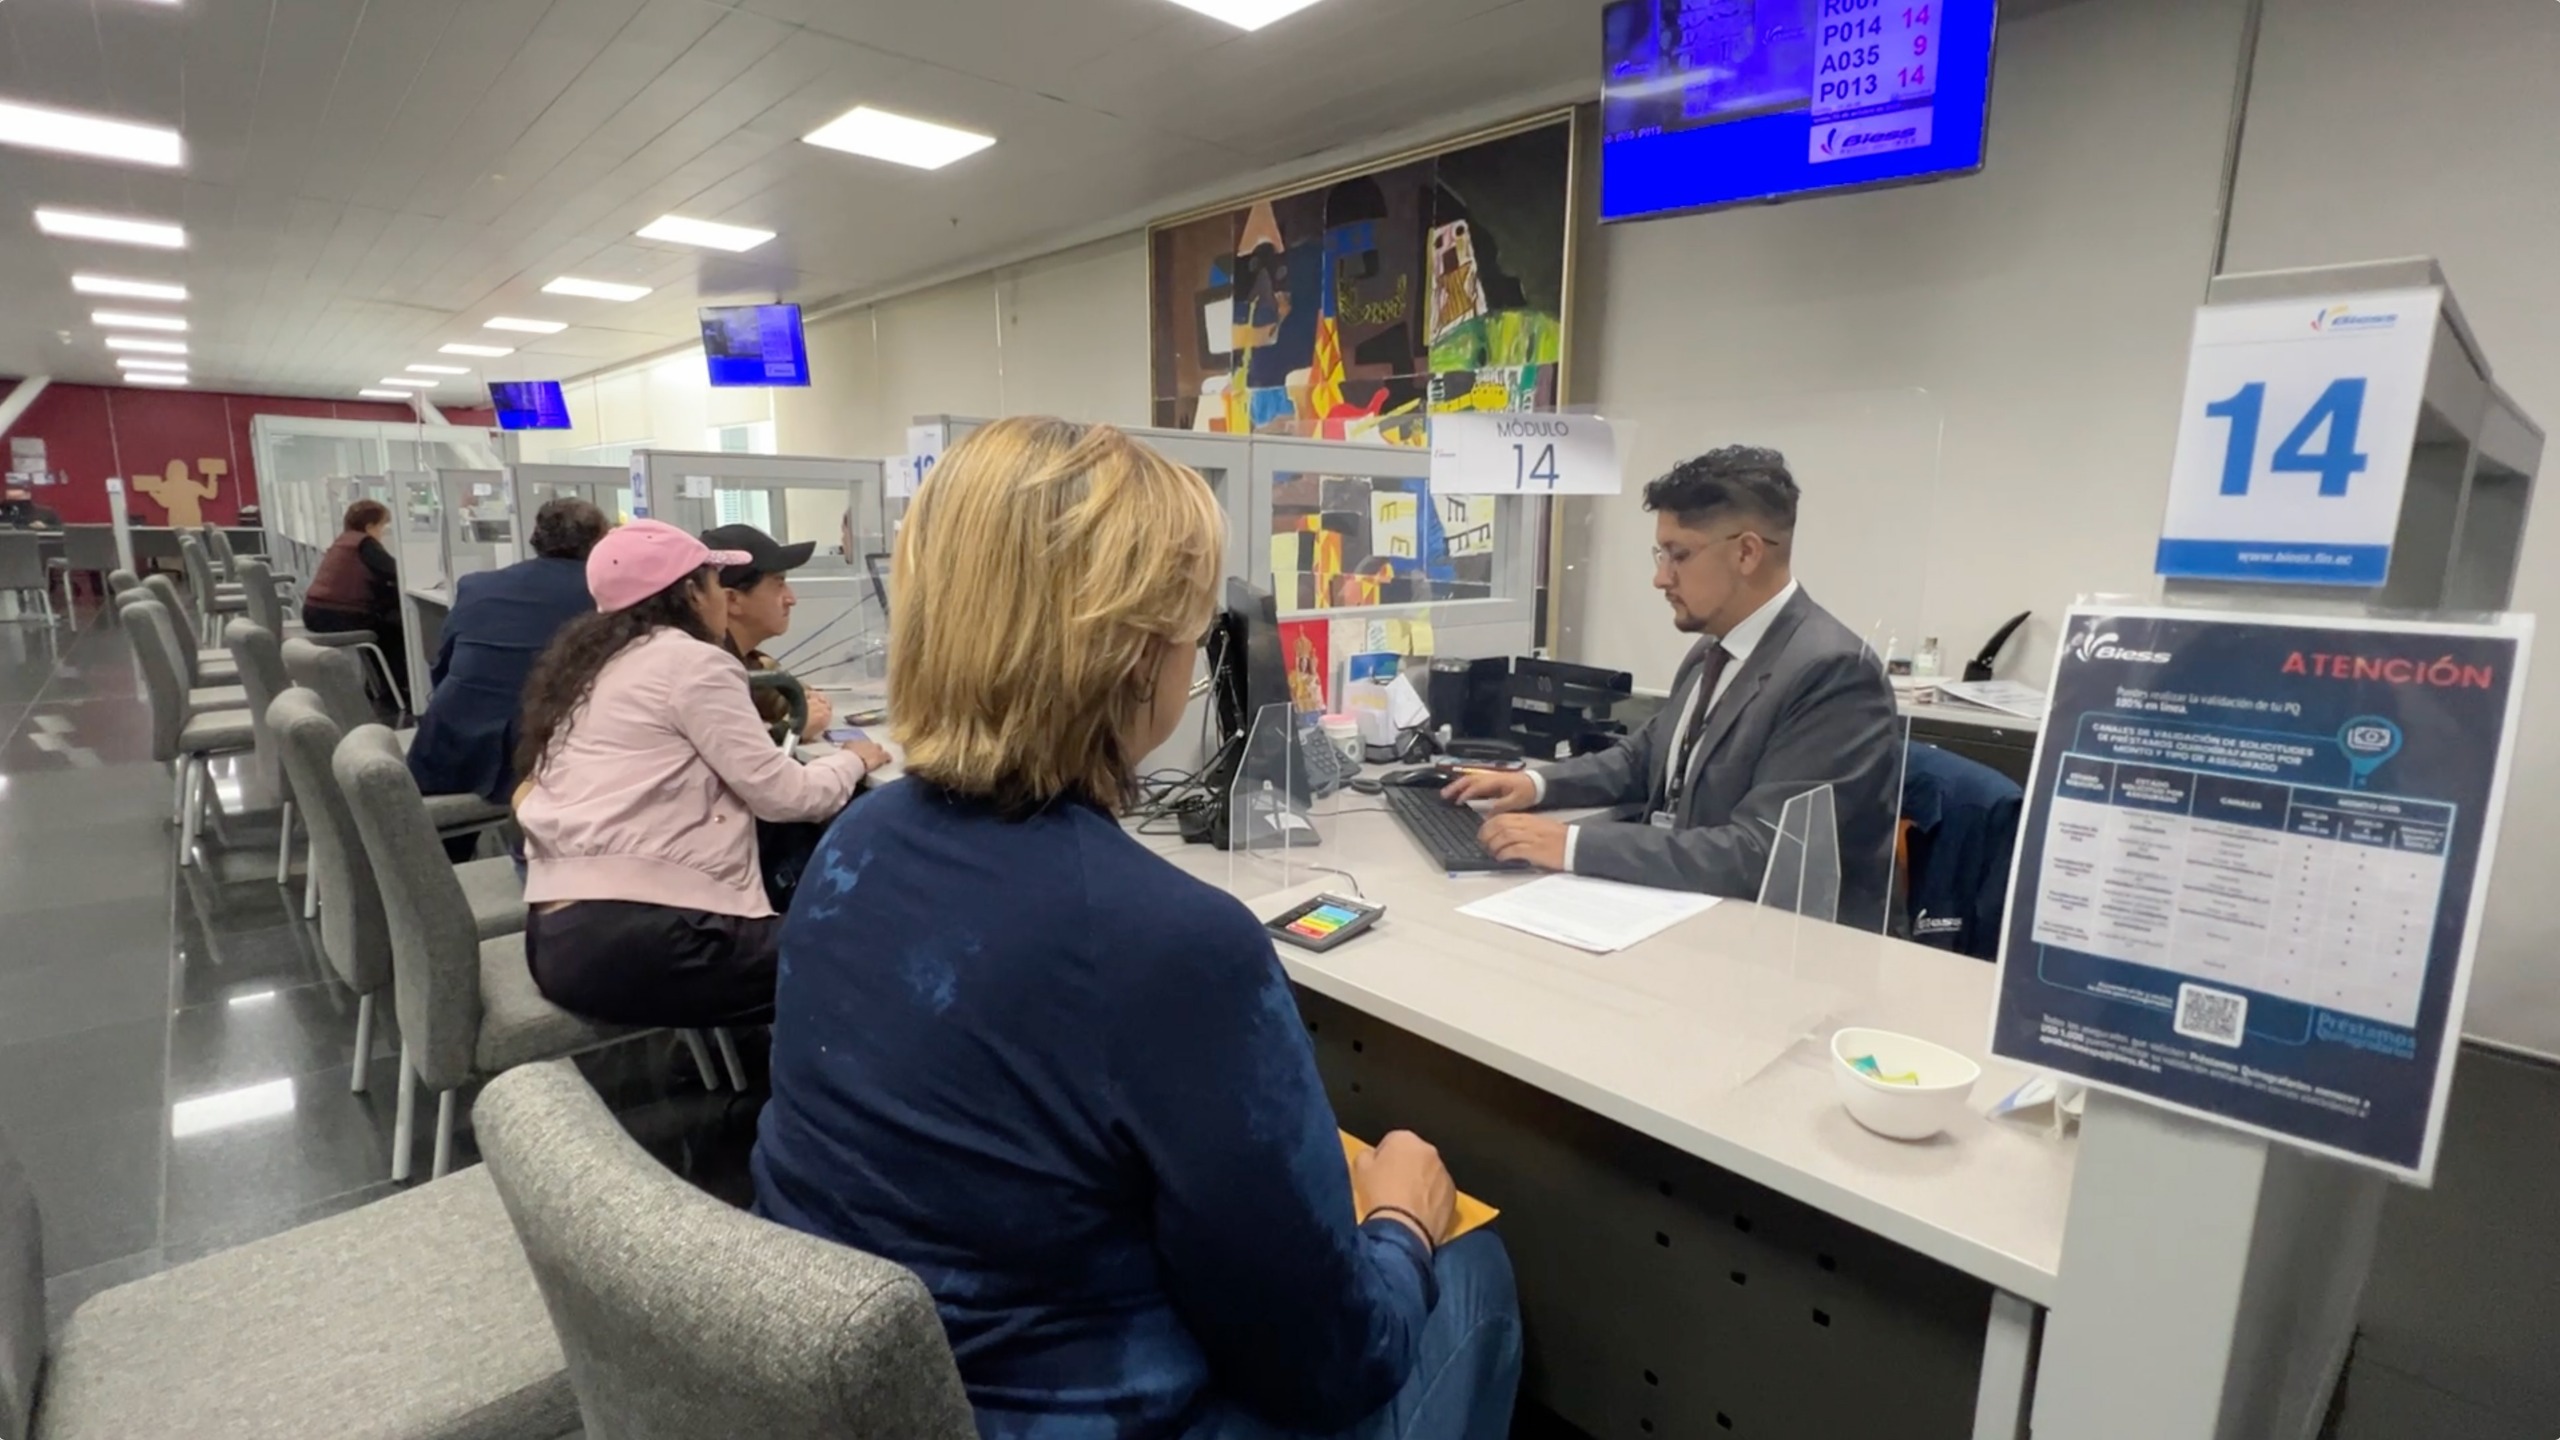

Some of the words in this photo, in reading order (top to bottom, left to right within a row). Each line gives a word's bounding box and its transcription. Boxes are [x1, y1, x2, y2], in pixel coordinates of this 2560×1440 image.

[1823, 16, 1881, 46] P014
[1902, 4, 1930, 28] 14
[1820, 44, 1879, 76] A035
[1913, 35, 1927, 56] 9
[1819, 74, 1877, 103] P013
[1897, 66, 1925, 88] 14
[1497, 421, 1569, 438] MÓDULO
[2206, 377, 2368, 497] 14
[1512, 444, 1560, 490] 14
[2096, 646, 2172, 664] Biess
[2282, 651, 2493, 689] ATENCIÓN
[2201, 695, 2254, 709] validación
[2255, 701, 2269, 711] de
[2270, 702, 2282, 712] tu
[2092, 723, 2135, 736] CANALES
[2136, 728, 2151, 737] DE
[2153, 730, 2220, 745] VALIDACIÓN
[2222, 738, 2236, 747] DE
[2239, 740, 2314, 757] SOLICITUDES
[2110, 734, 2174, 749] PRÉSTAMOS
[2277, 754, 2303, 766] POR
